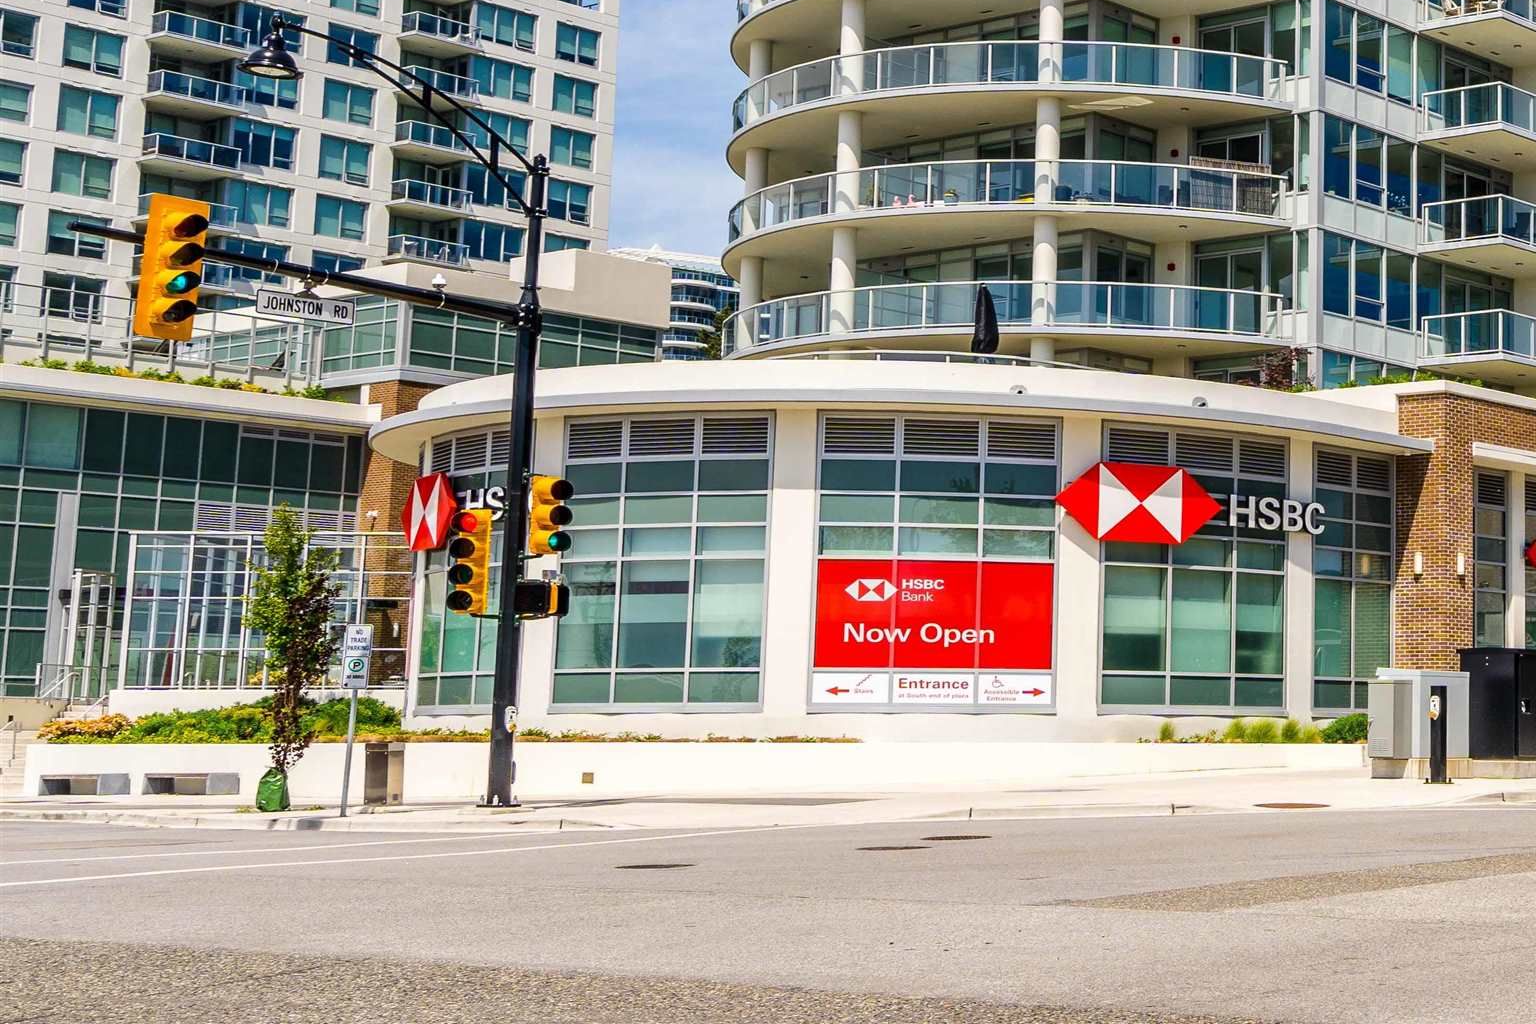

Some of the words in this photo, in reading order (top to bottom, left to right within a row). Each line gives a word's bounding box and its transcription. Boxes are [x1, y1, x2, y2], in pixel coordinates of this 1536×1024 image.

[263, 295, 323, 316] JOHNSTON
[333, 304, 349, 319] RD
[1229, 493, 1325, 535] HSBC
[901, 578, 945, 590] HSBC
[901, 591, 934, 602] Bank
[843, 622, 912, 643] Now
[919, 622, 995, 648] Open
[353, 661, 361, 670] P
[898, 678, 969, 690] Entrance
